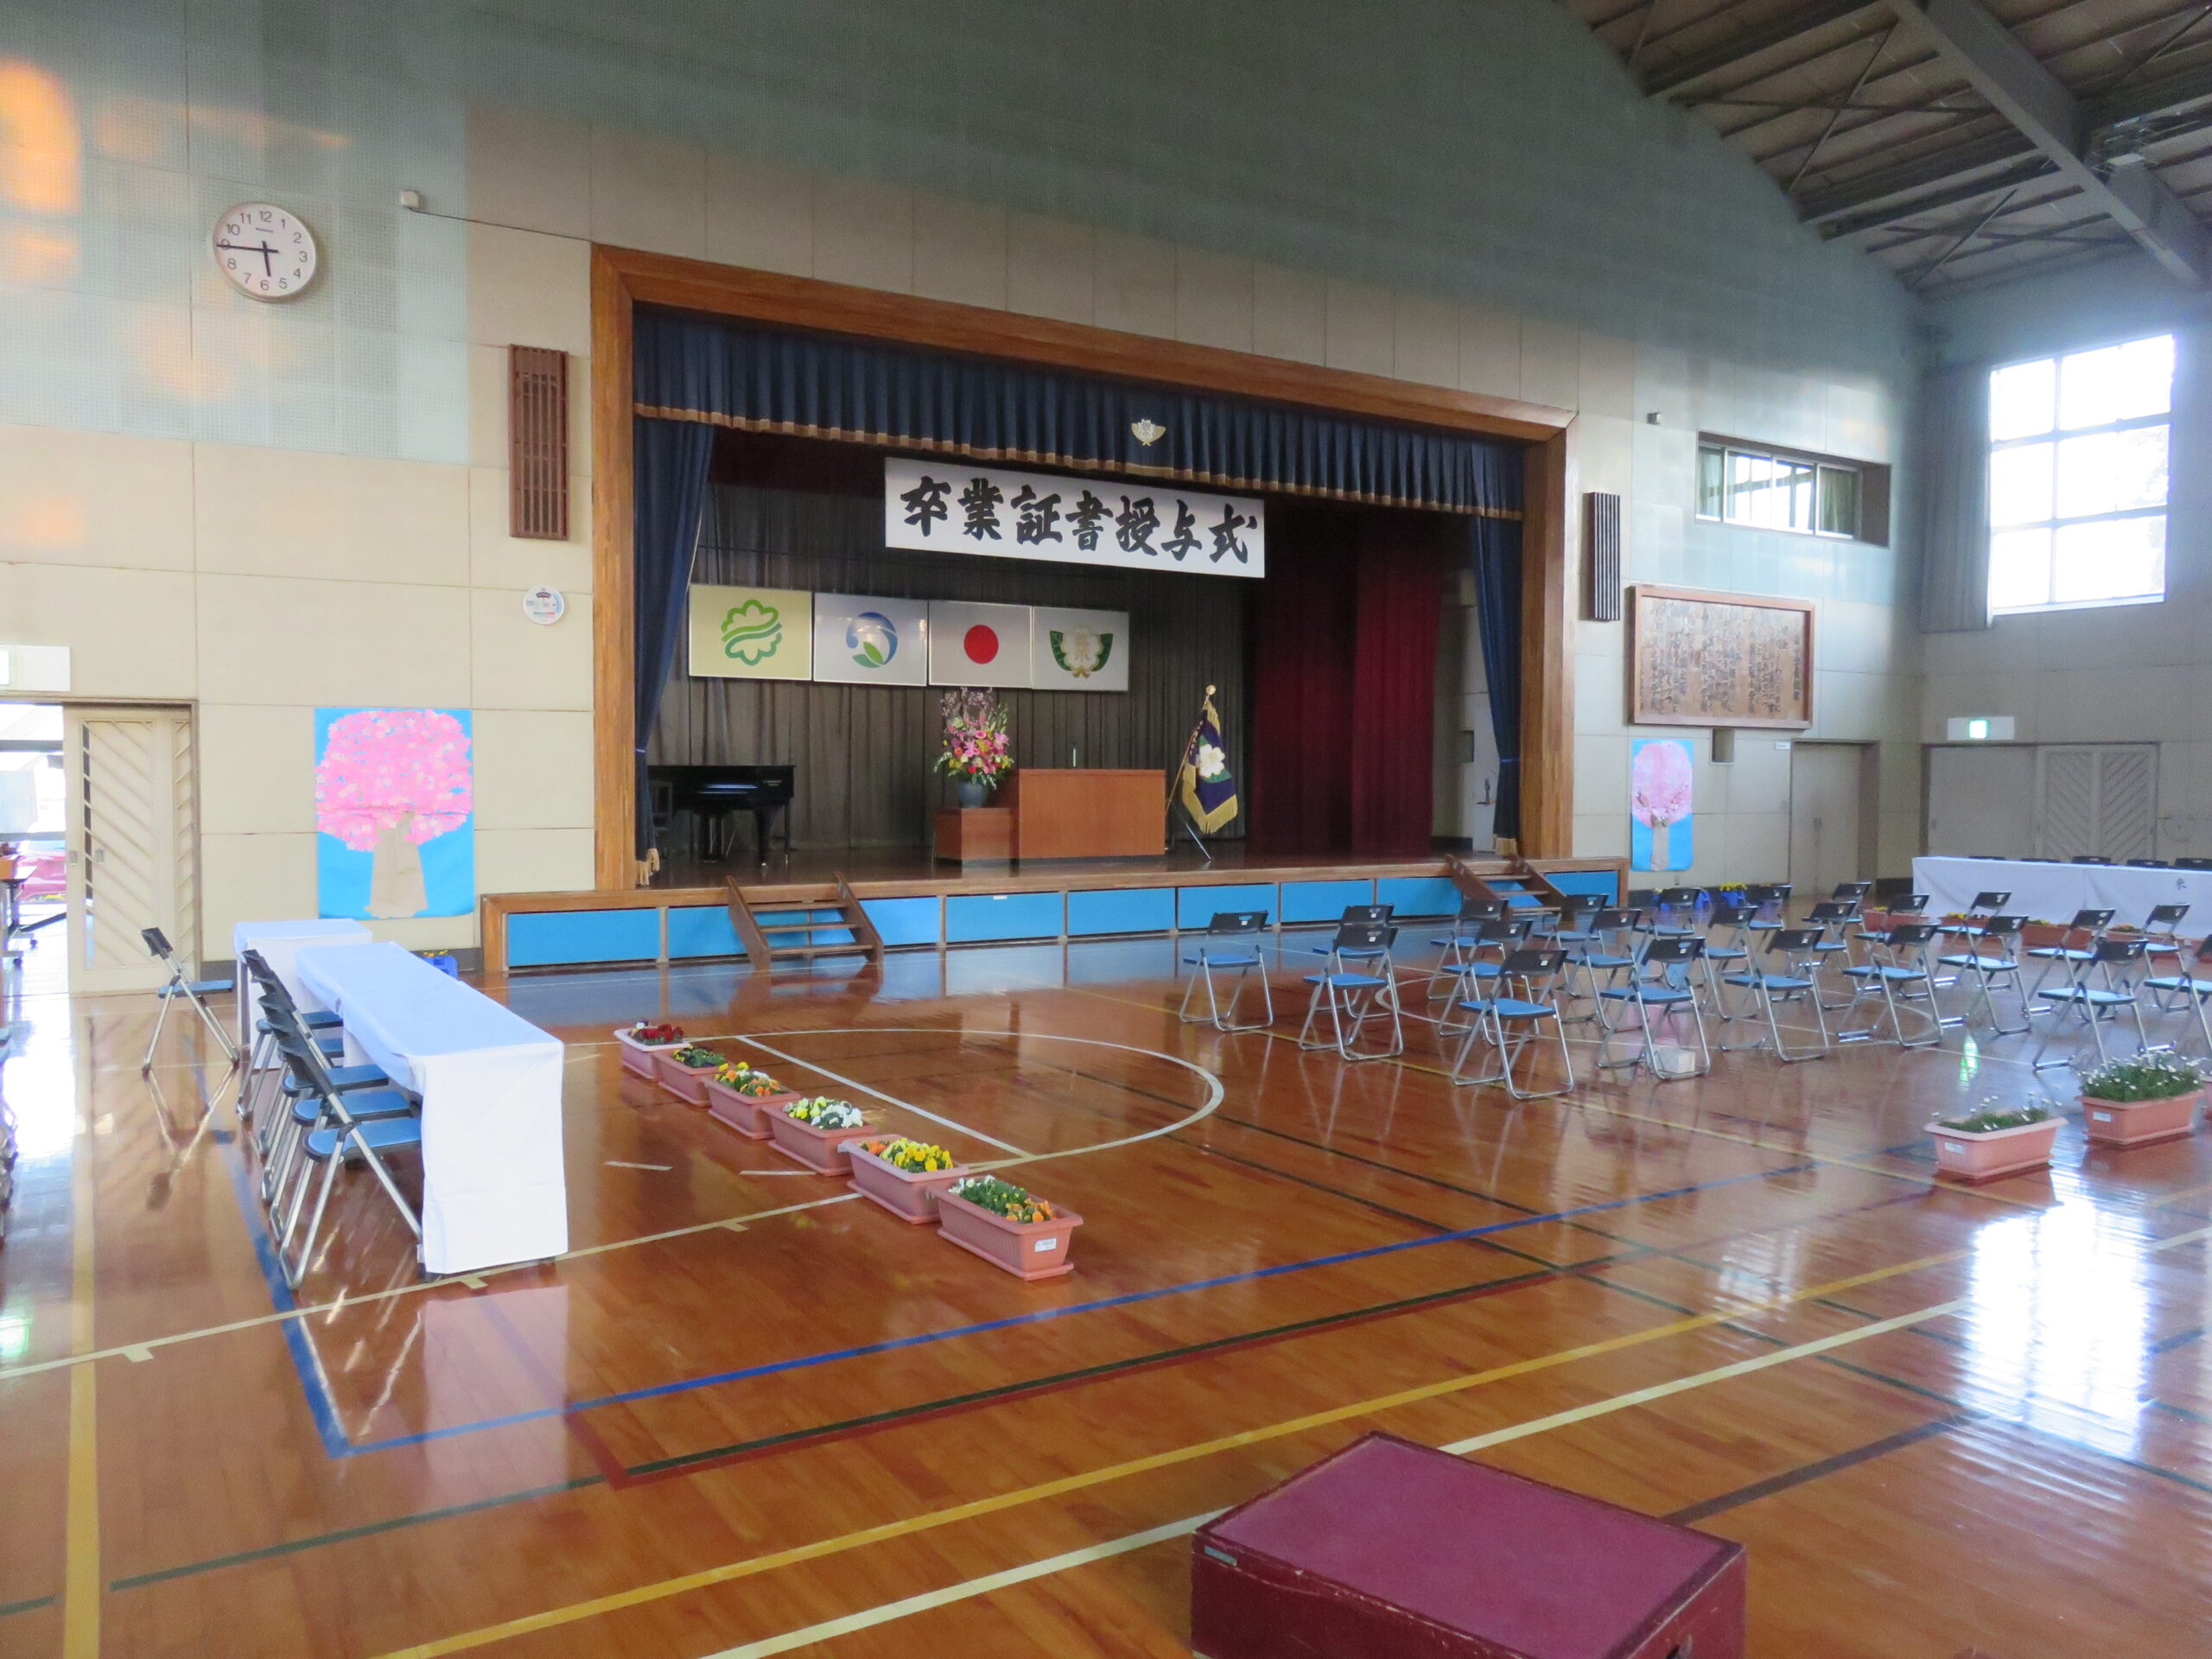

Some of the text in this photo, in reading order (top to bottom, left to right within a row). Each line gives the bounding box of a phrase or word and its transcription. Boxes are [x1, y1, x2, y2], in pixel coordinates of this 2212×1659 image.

[240, 213, 251, 225] 11
[258, 210, 272, 223] 12
[226, 224, 240, 236] 10
[281, 219, 286, 229] 1
[293, 232, 302, 244] 2
[298, 251, 308, 263] 3
[227, 257, 237, 270] 8
[244, 272, 252, 284] 7
[293, 268, 302, 279] 4
[260, 279, 270, 291] 6
[278, 277, 288, 289] 5
[899, 475, 1258, 564] 卒業証書授与式
